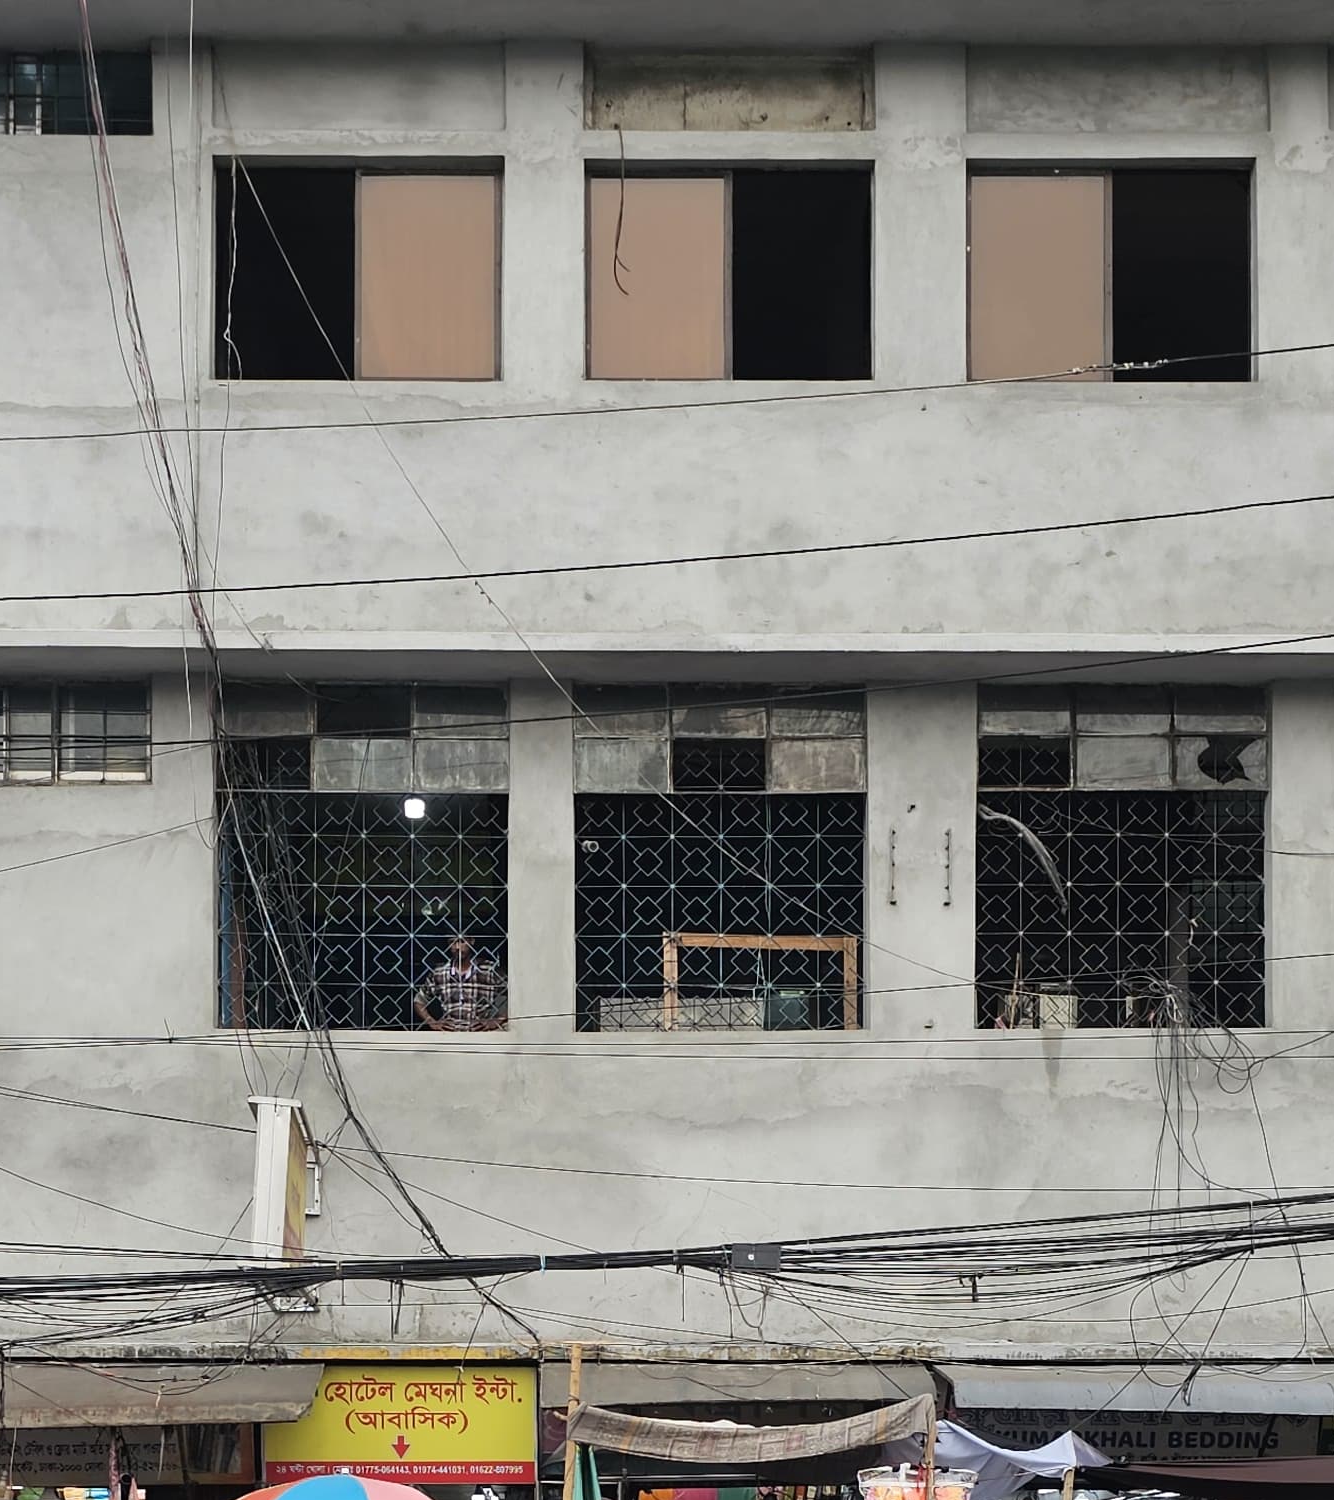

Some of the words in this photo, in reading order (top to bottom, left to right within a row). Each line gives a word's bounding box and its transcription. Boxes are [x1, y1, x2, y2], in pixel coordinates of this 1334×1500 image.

[324, 1374, 396, 1405] হোটেল
[404, 1379, 467, 1404] মেঘনা
[345, 1406, 469, 1434] (আবাসিক)
[998, 1430, 1156, 1450] KUMAKHALI
[1168, 1431, 1279, 1450] BEDDING
